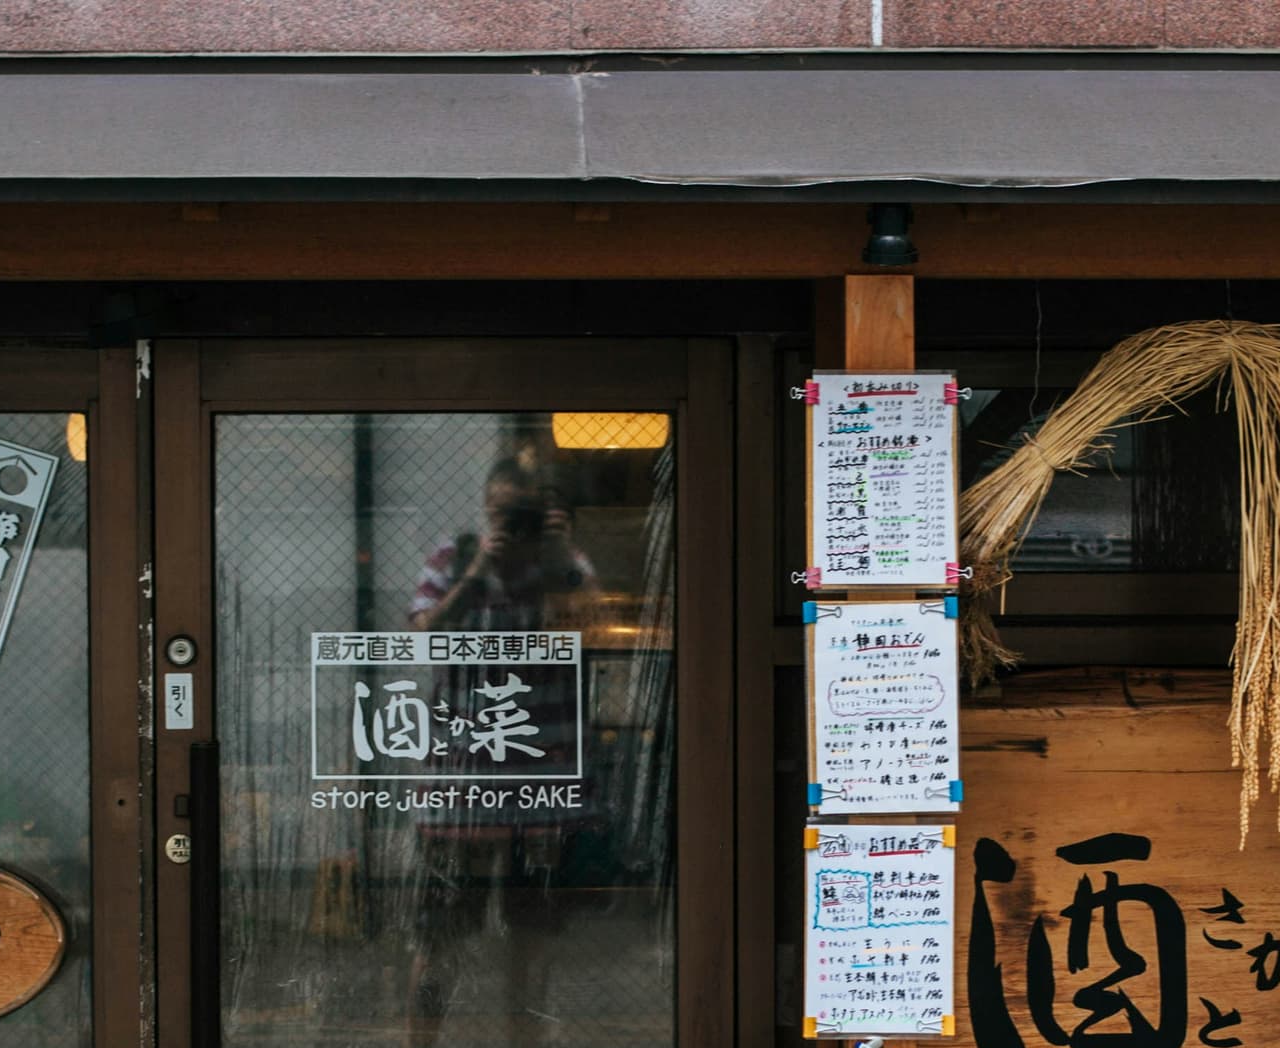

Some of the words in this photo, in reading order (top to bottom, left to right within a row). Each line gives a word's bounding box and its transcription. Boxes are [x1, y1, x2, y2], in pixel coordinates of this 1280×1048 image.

[317, 634, 415, 662] 蔵元直送
[428, 634, 575, 662] 日本酒専門店
[171, 685, 186, 717] 引く
[311, 786, 391, 809] store
[396, 786, 463, 812] just
[465, 785, 513, 809] for
[518, 784, 583, 809] SAKE
